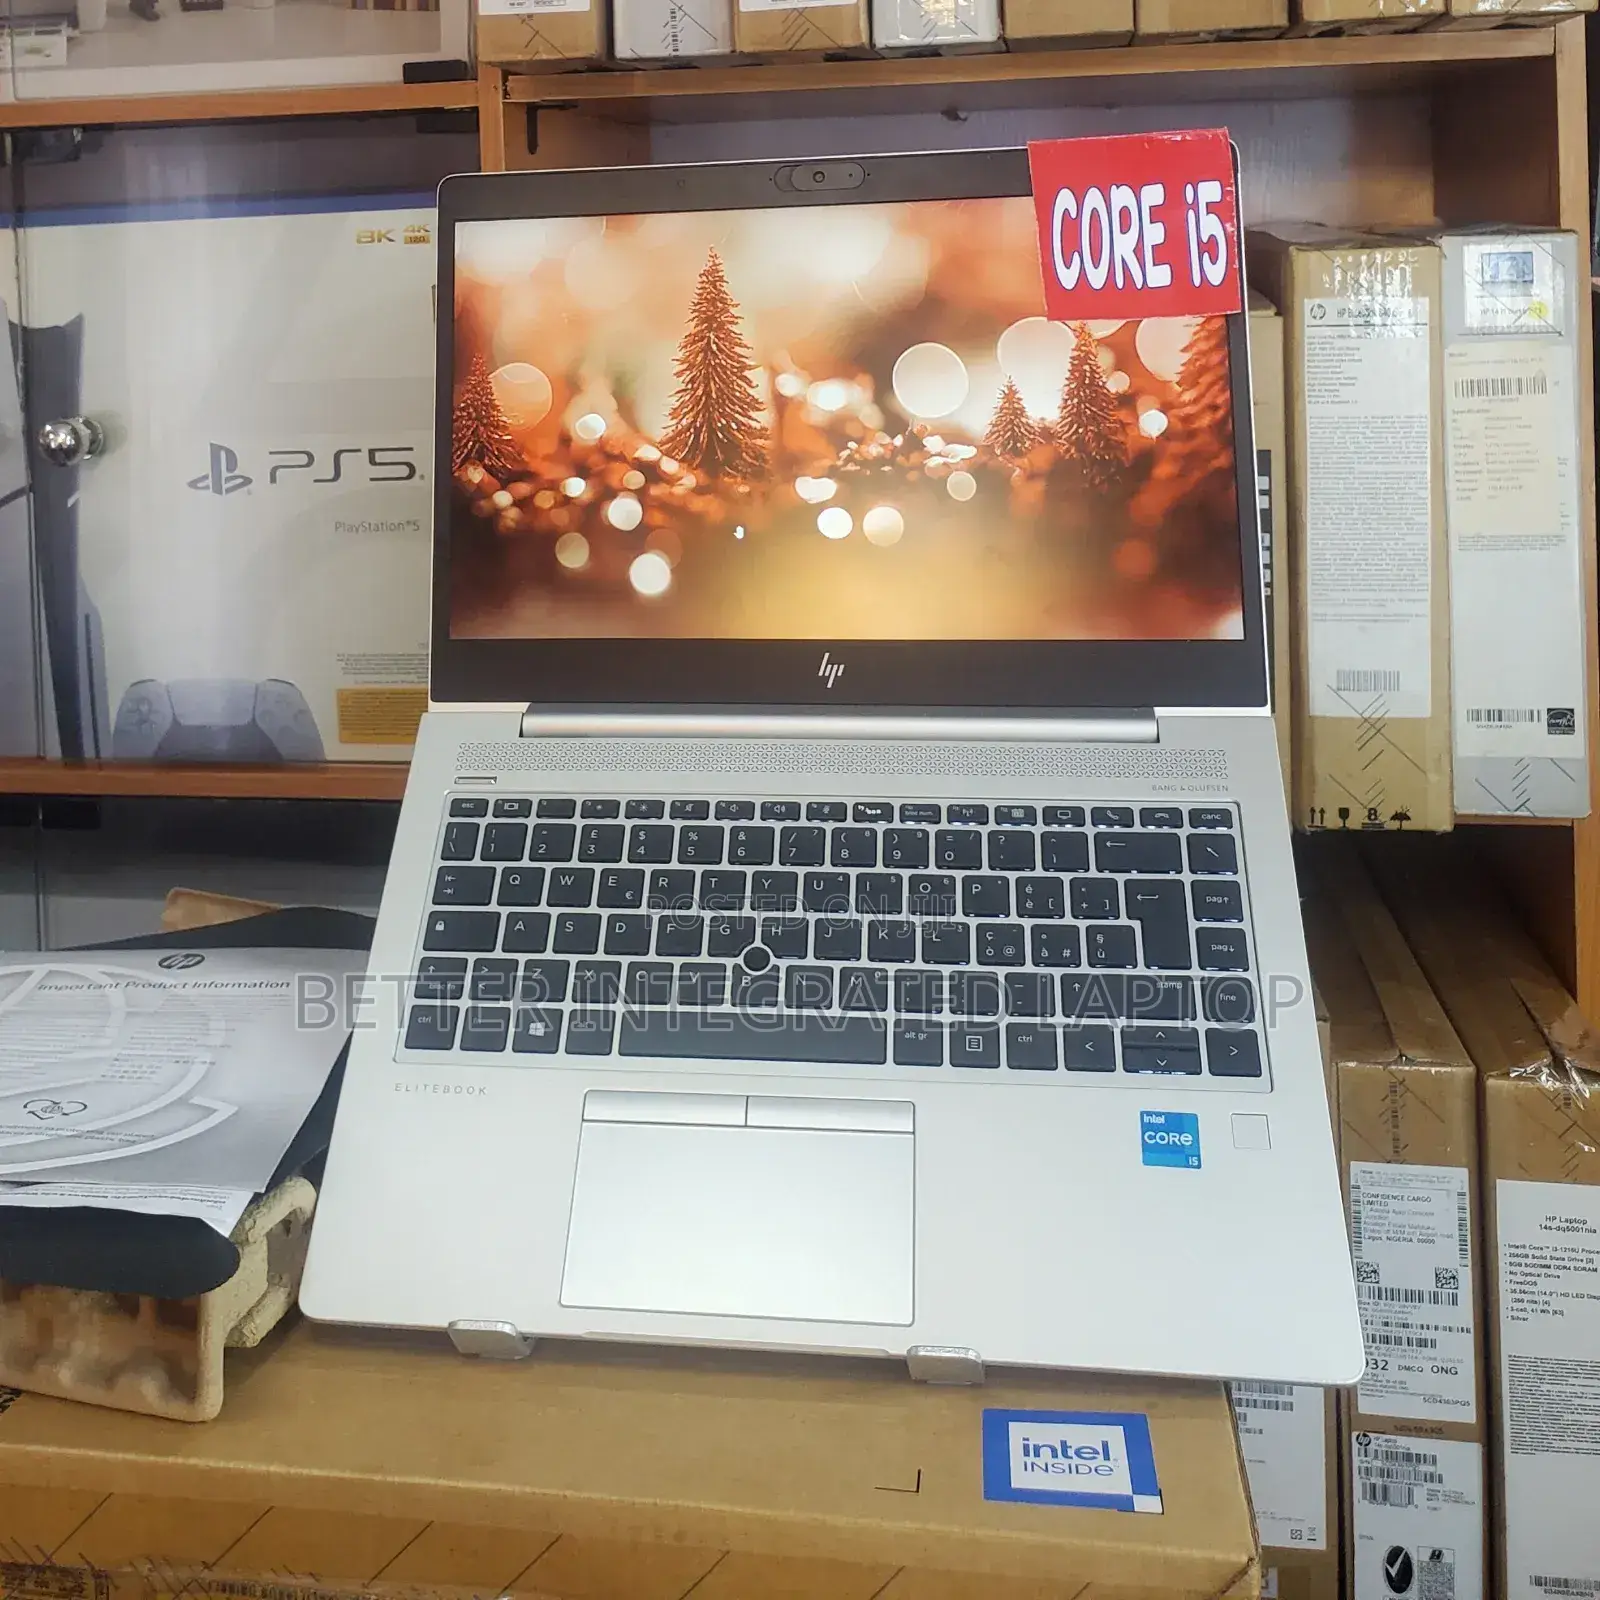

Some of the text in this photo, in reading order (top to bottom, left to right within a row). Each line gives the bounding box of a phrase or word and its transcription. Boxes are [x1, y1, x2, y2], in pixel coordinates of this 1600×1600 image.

[403, 223, 432, 233] 4K
[356, 228, 396, 245] 8K
[1052, 180, 1228, 291] CORE i5
[268, 447, 417, 484] PS5
[818, 652, 845, 689] hp
[1152, 784, 1177, 792] BANG
[1187, 784, 1229, 792] OLUFSEN
[1201, 812, 1222, 820] canc
[590, 829, 598, 839] £
[639, 830, 646, 840] $
[688, 831, 698, 841] %
[737, 831, 746, 841] &
[538, 844, 547, 854] 2
[587, 844, 596, 854] 3
[637, 845, 646, 855] 4
[686, 846, 695, 856] 5
[737, 847, 746, 857] 6
[788, 847, 797, 858] 7
[840, 848, 849, 859] 8
[892, 849, 902, 860] 9
[509, 874, 520, 886] Q
[560, 875, 574, 886] W
[608, 876, 618, 887] E
[658, 877, 669, 888] R
[709, 877, 719, 888] T
[761, 878, 772, 889] Y
[813, 880, 824, 891] U
[919, 882, 932, 893] O
[972, 884, 982, 895] P
[625, 890, 634, 900] €
[1206, 895, 1223, 904] pag
[514, 920, 525, 931] A
[565, 921, 574, 932] S
[615, 922, 626, 933] D
[666, 923, 675, 934] F
[719, 924, 731, 935] G
[771, 925, 782, 936] H
[824, 927, 832, 938] J
[878, 929, 889, 940] K
[932, 931, 941, 942] L
[1003, 945, 1016, 956] @
[1062, 948, 1071, 958] #
[1211, 943, 1228, 952] pag
[532, 968, 542, 979] Z
[584, 969, 595, 981] X
[636, 970, 647, 981] C
[689, 971, 700, 983] V
[38, 979, 291, 992] Important Product Information
[741, 975, 751, 987] B
[796, 974, 807, 986] N
[851, 976, 862, 987] M
[1219, 993, 1237, 1002] fine
[417, 1015, 432, 1024] ctrl
[904, 1031, 928, 1041] alt gr
[1017, 1034, 1033, 1043] ctrl
[394, 1082, 487, 1096] ELITEBOOK
[1143, 1113, 1165, 1124] intel
[1188, 1156, 1199, 1166] i5
[1361, 1192, 1432, 1204] CONFIDENCE CARGO
[1545, 1215, 1588, 1226] HP Laptop
[1573, 1265, 1598, 1273] SDRAM
[1430, 1365, 1459, 1376] ONG
[1022, 1437, 1111, 1461] intel
